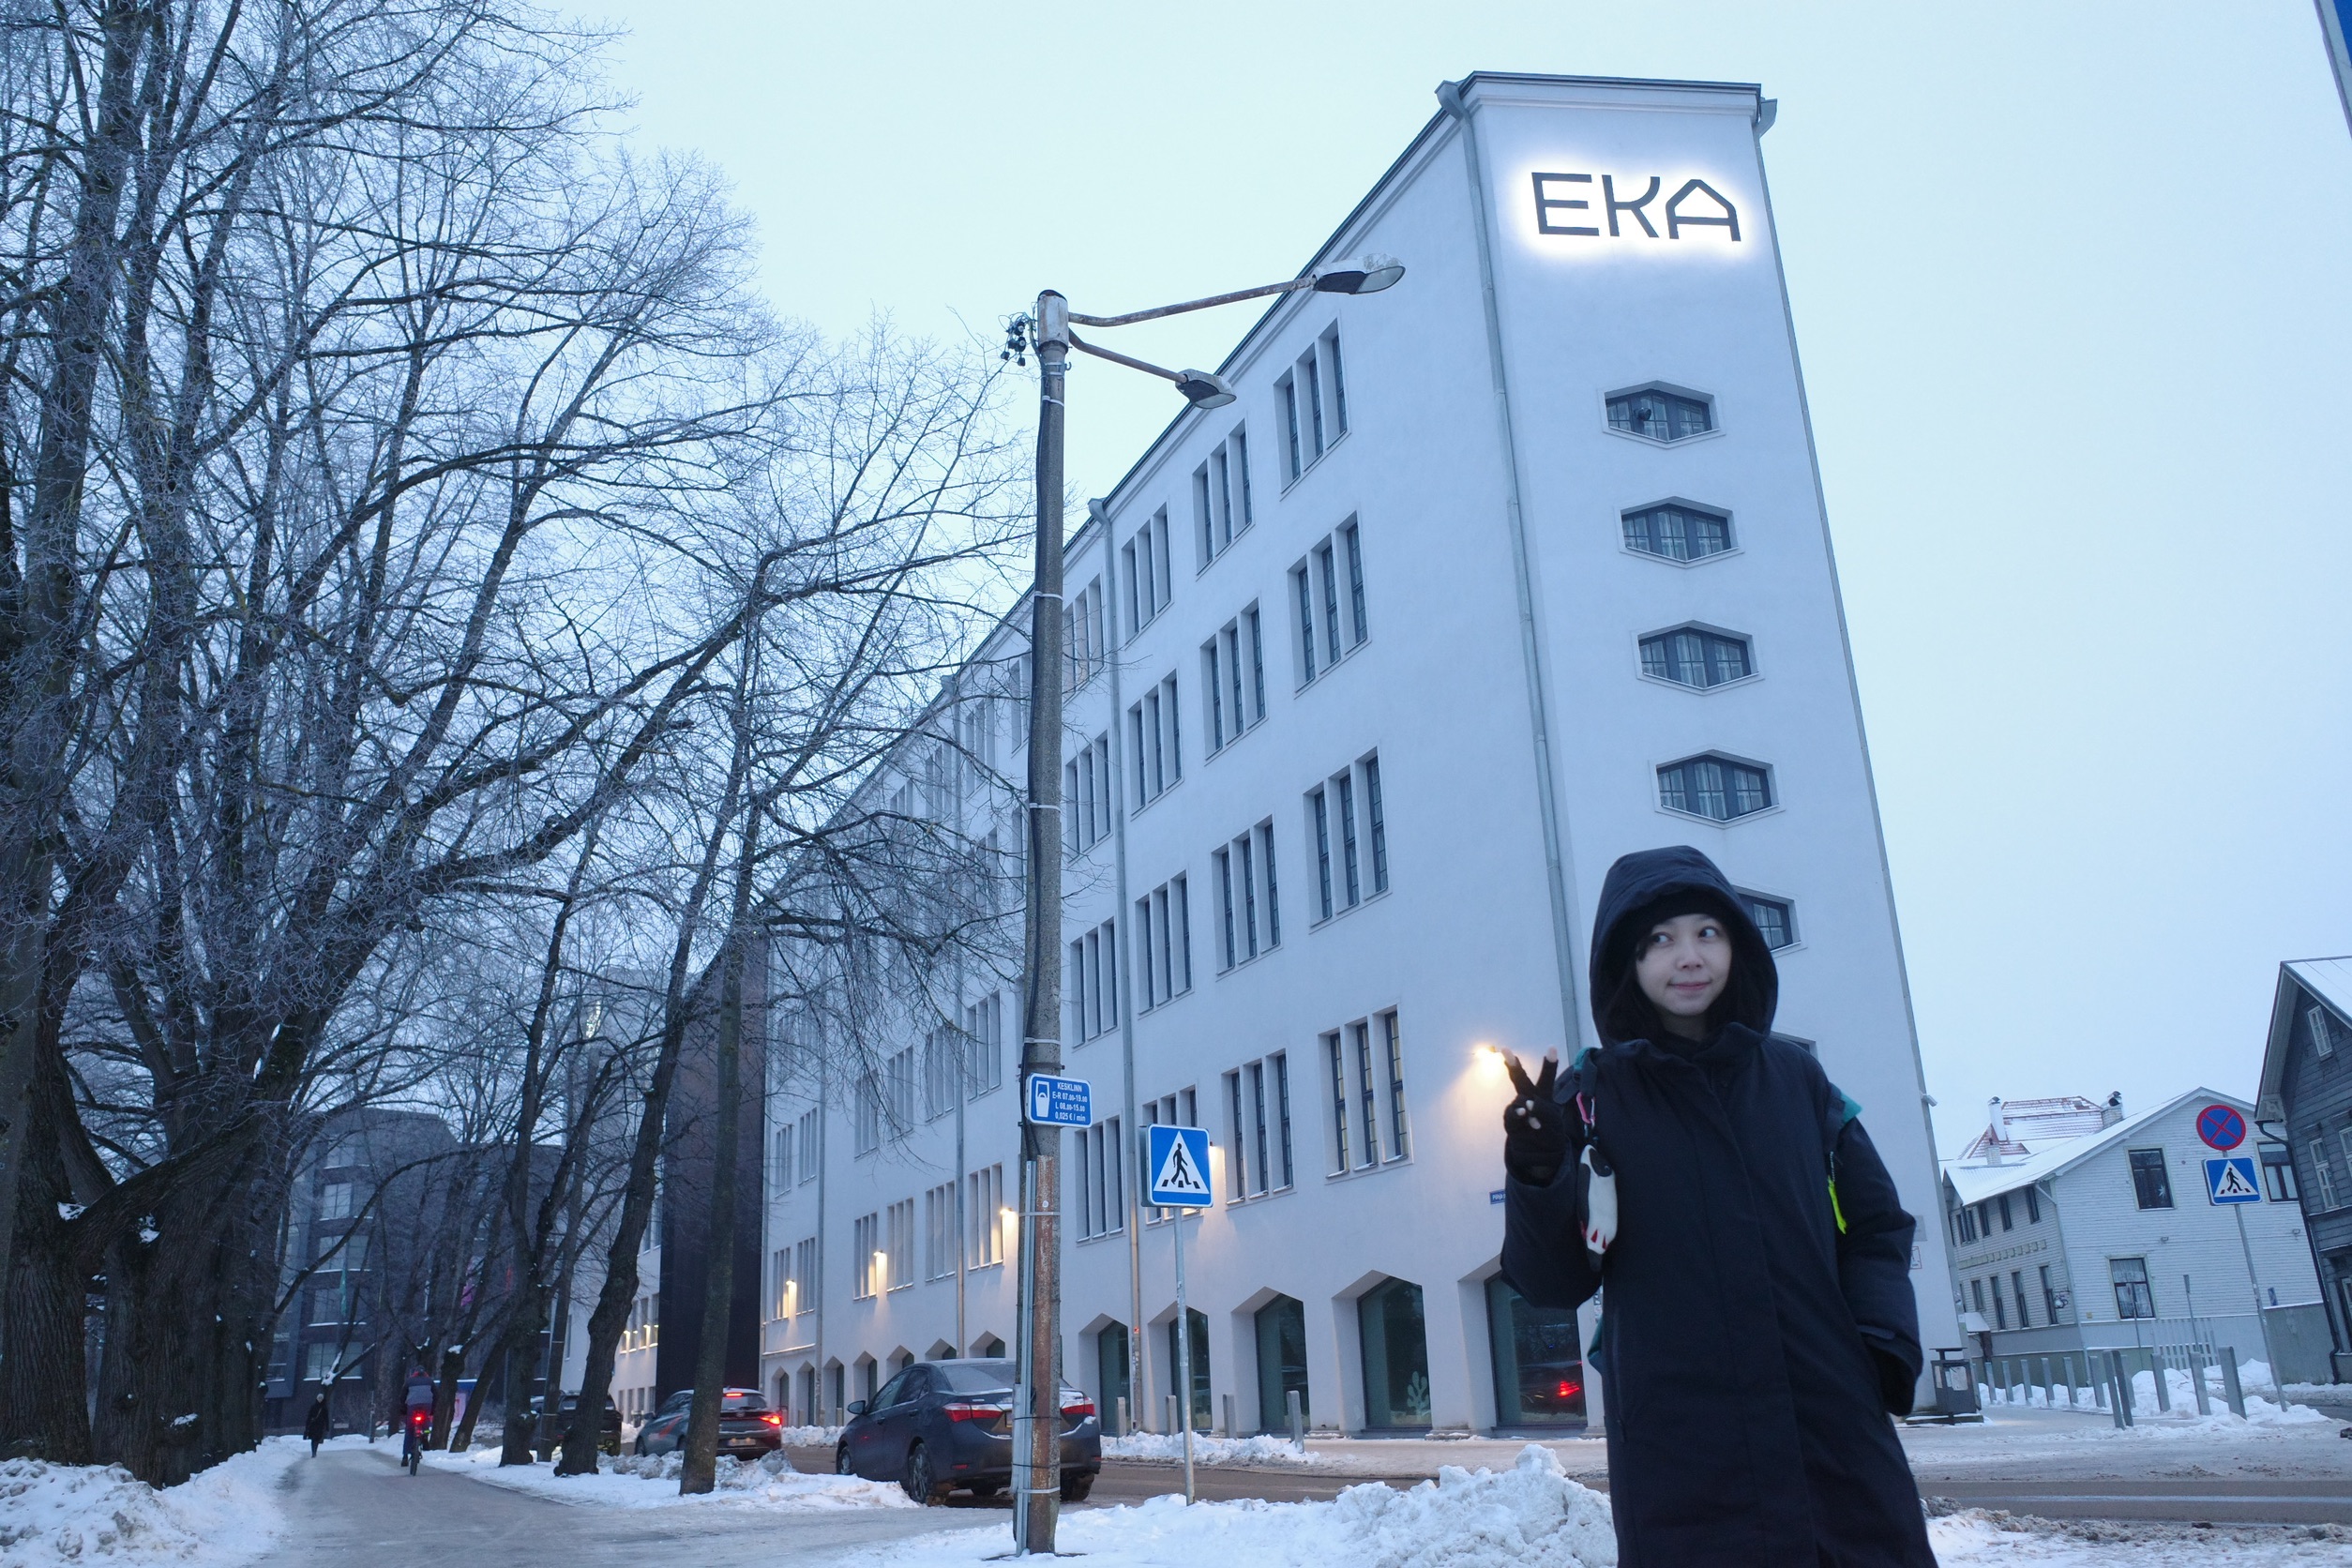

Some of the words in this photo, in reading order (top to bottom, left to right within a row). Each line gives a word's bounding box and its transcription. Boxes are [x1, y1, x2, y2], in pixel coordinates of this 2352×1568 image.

[1531, 173, 1741, 242] EKA
[1057, 1081, 1082, 1093] KESKLINN
[1052, 1091, 1062, 1100] E-R
[1055, 1101, 1059, 1109] L
[1055, 1111, 1068, 1121] 0,025
[1076, 1113, 1086, 1123] min
